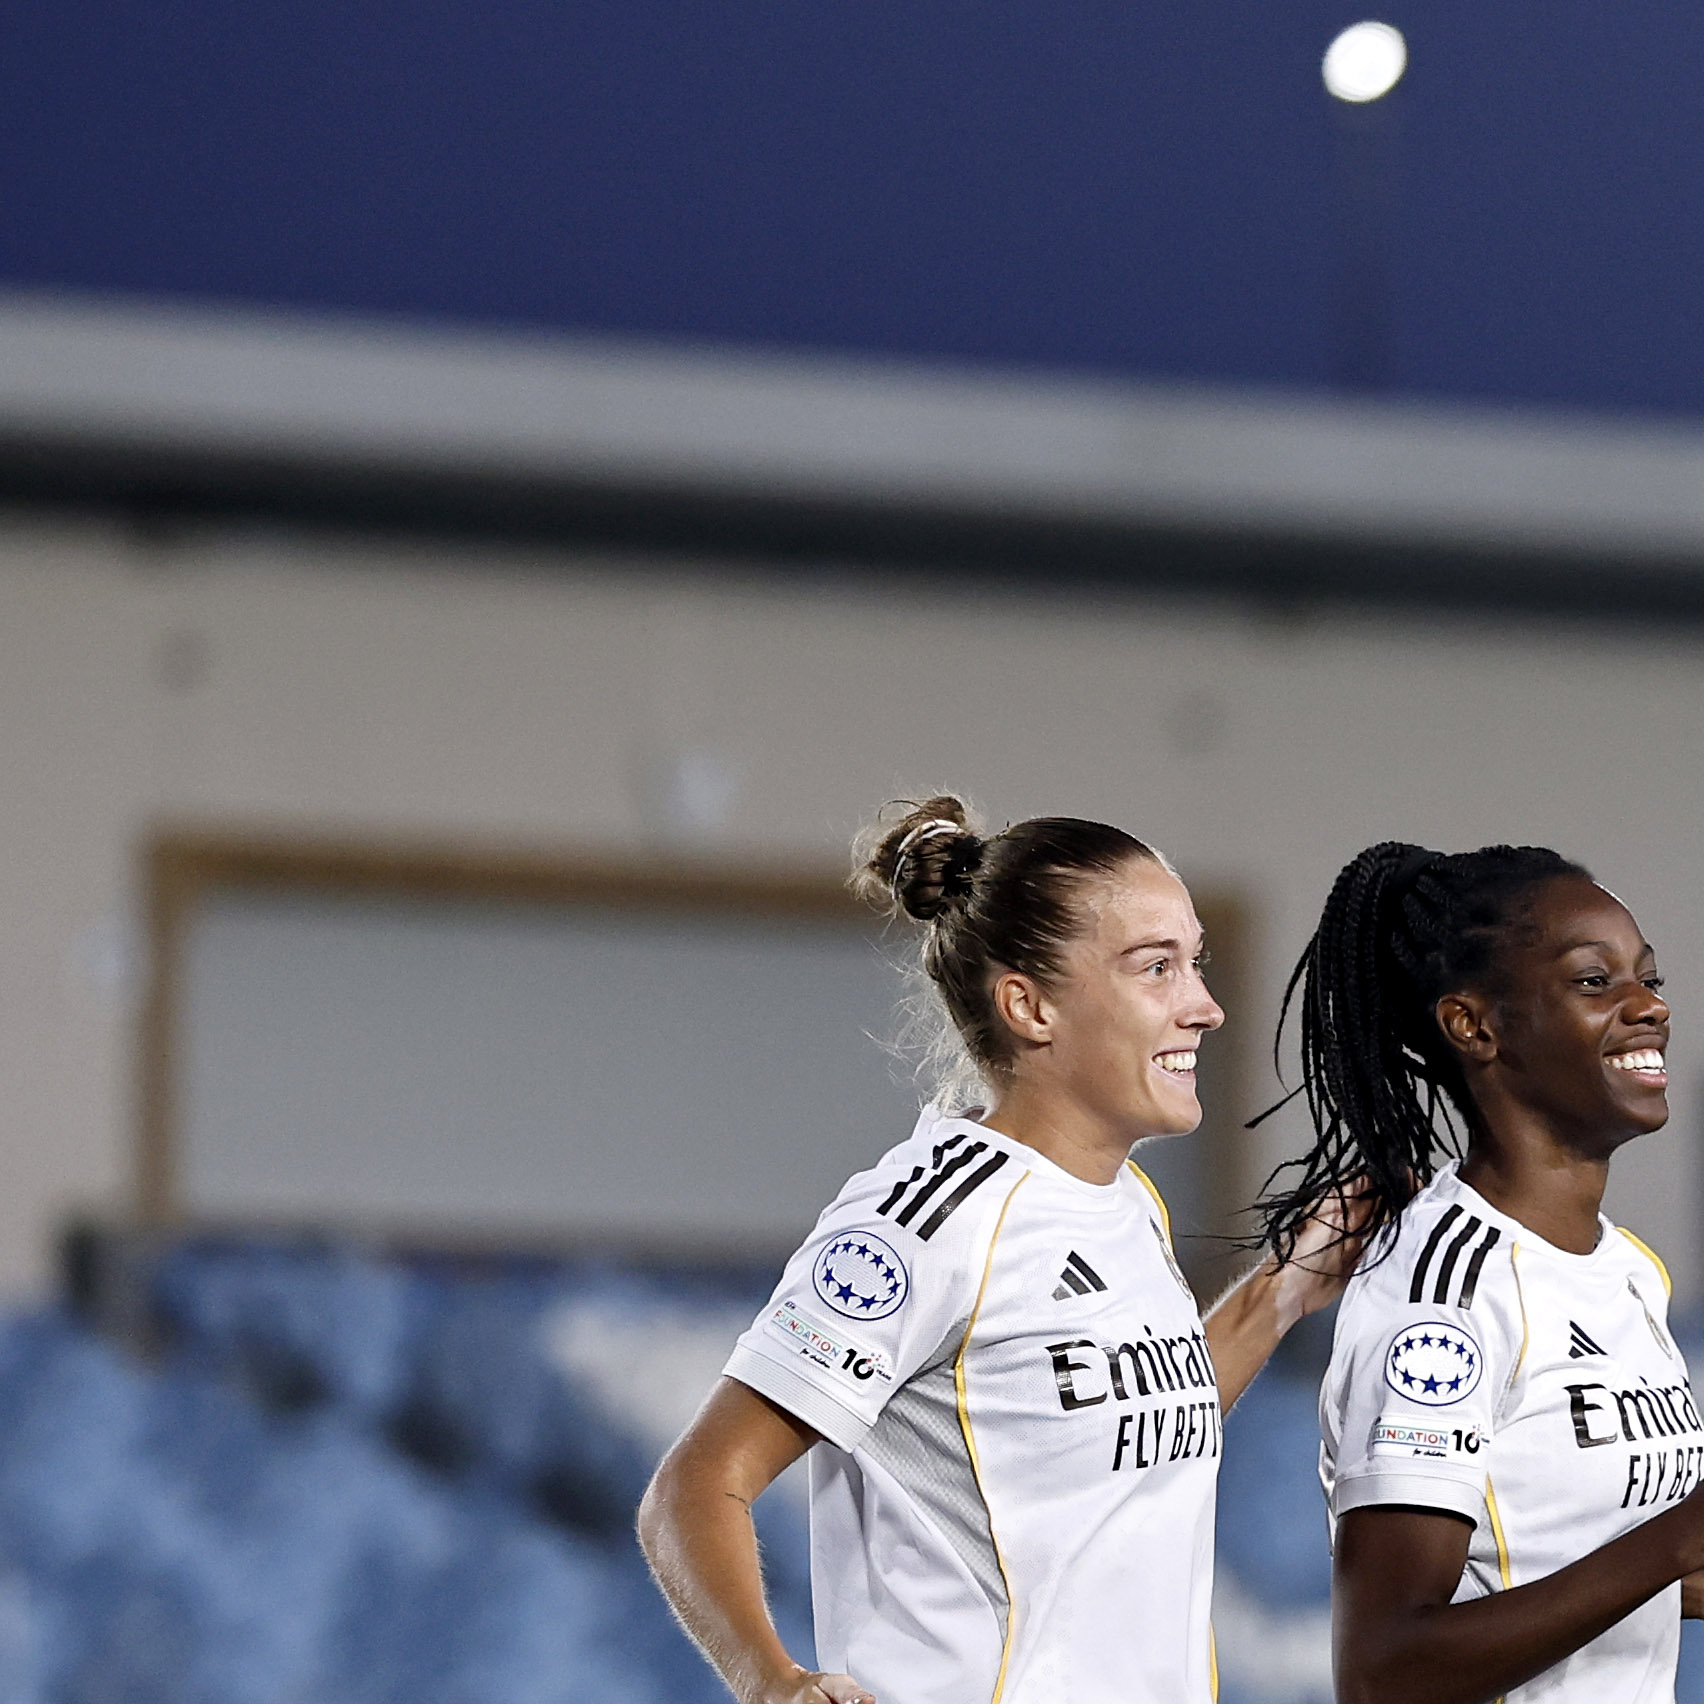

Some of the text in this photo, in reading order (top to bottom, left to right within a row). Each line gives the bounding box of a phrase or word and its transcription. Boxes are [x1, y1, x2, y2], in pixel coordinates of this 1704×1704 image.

[773, 1310, 841, 1358] FOUNDATION
[1044, 1325, 1217, 1411] Emirat
[1112, 1401, 1220, 1472] FLY BETT
[1376, 1429, 1448, 1445] UNDATION
[1620, 1452, 1667, 1508] FLY
